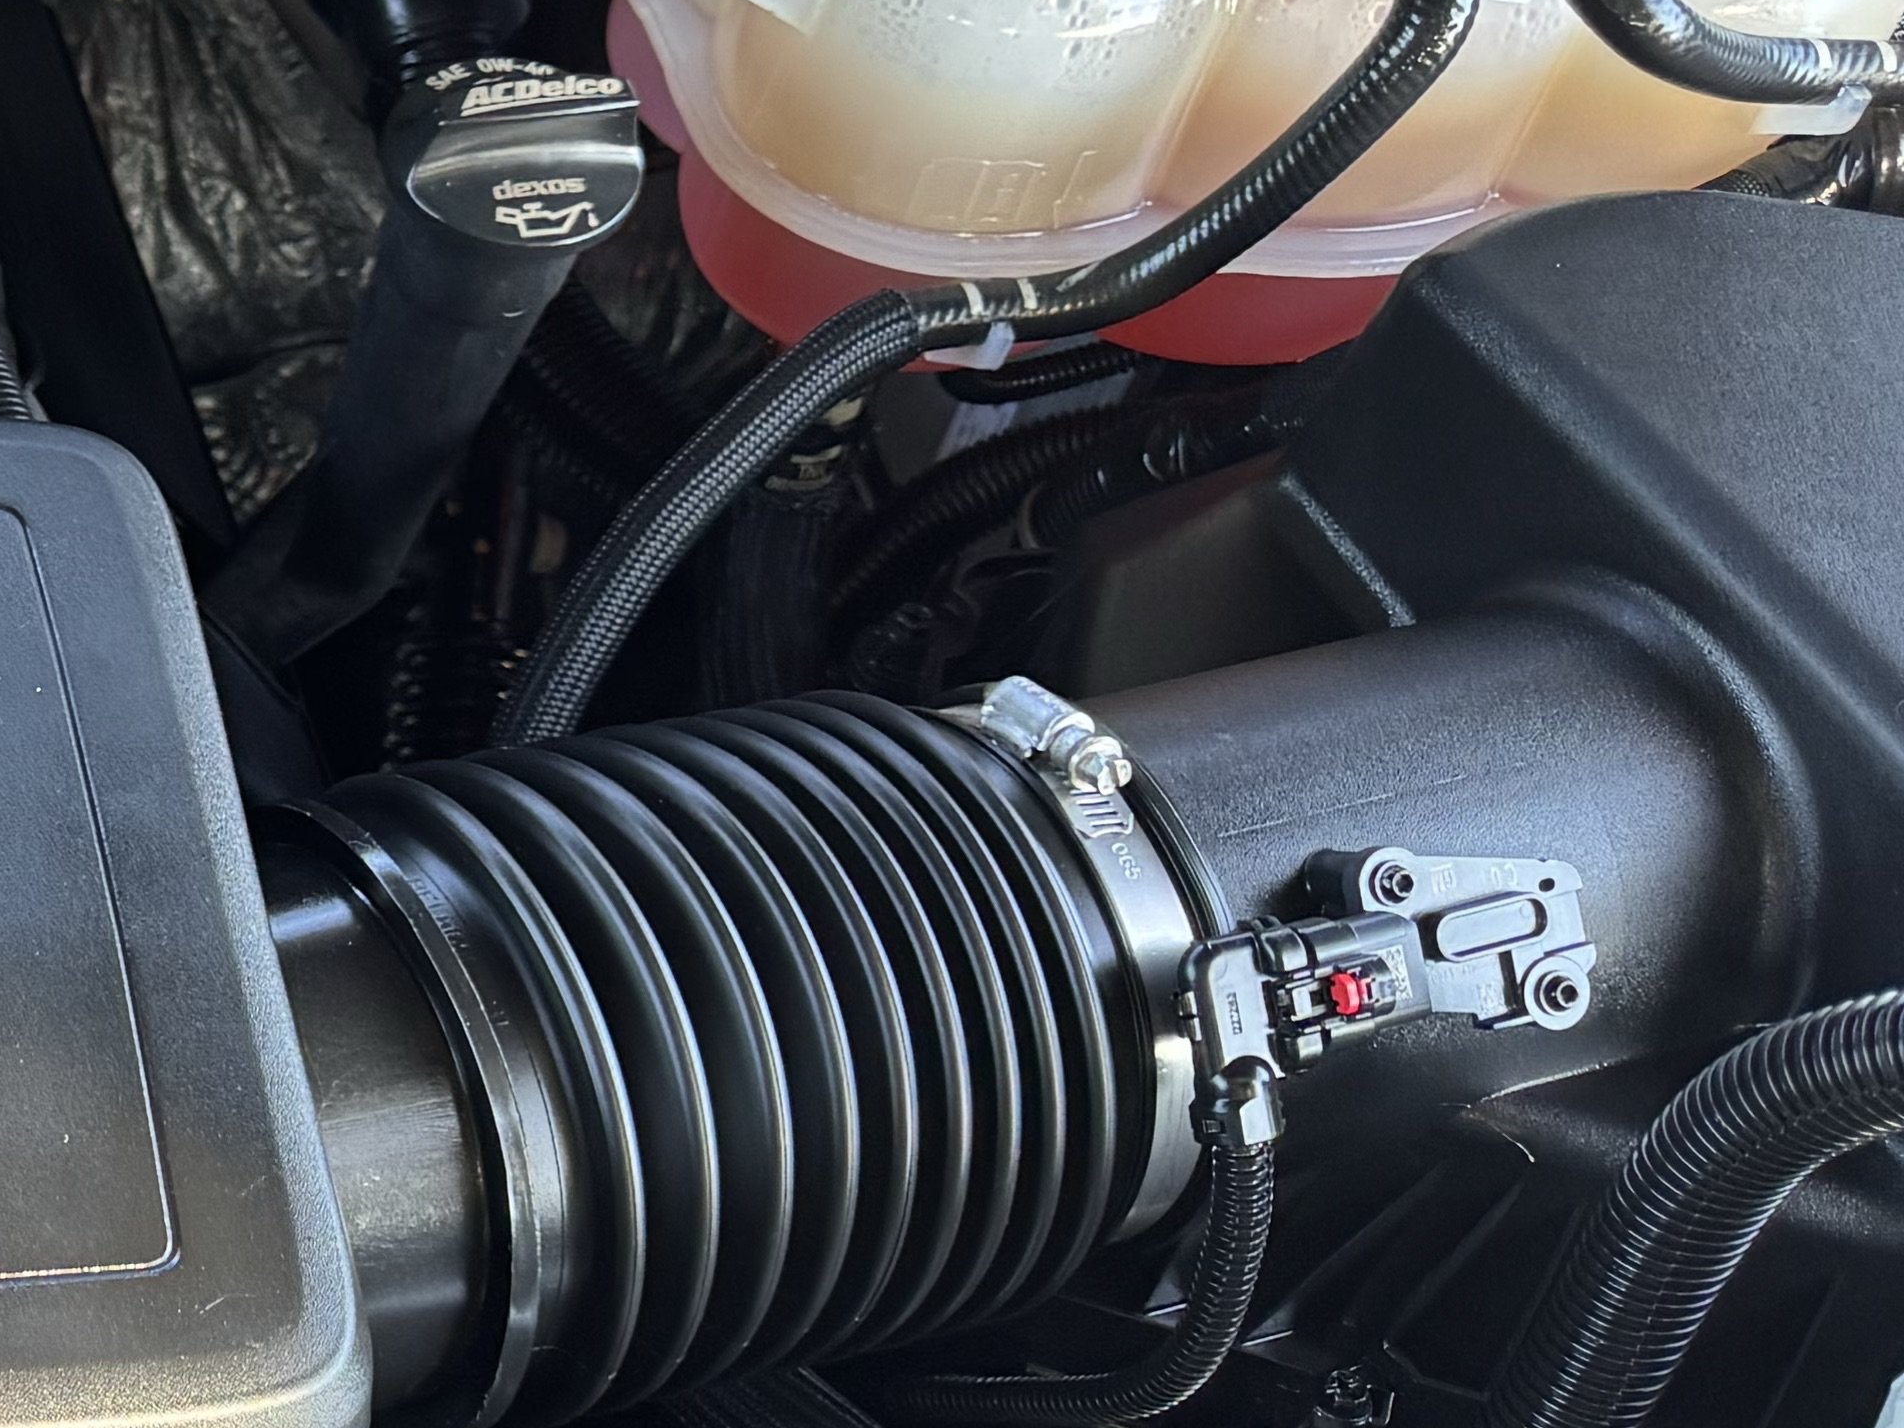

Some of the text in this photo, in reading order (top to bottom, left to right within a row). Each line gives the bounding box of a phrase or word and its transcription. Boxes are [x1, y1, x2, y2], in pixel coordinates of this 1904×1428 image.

[425, 62, 472, 90] SAE
[460, 75, 625, 110] ACDelco
[492, 177, 587, 200] dexos
